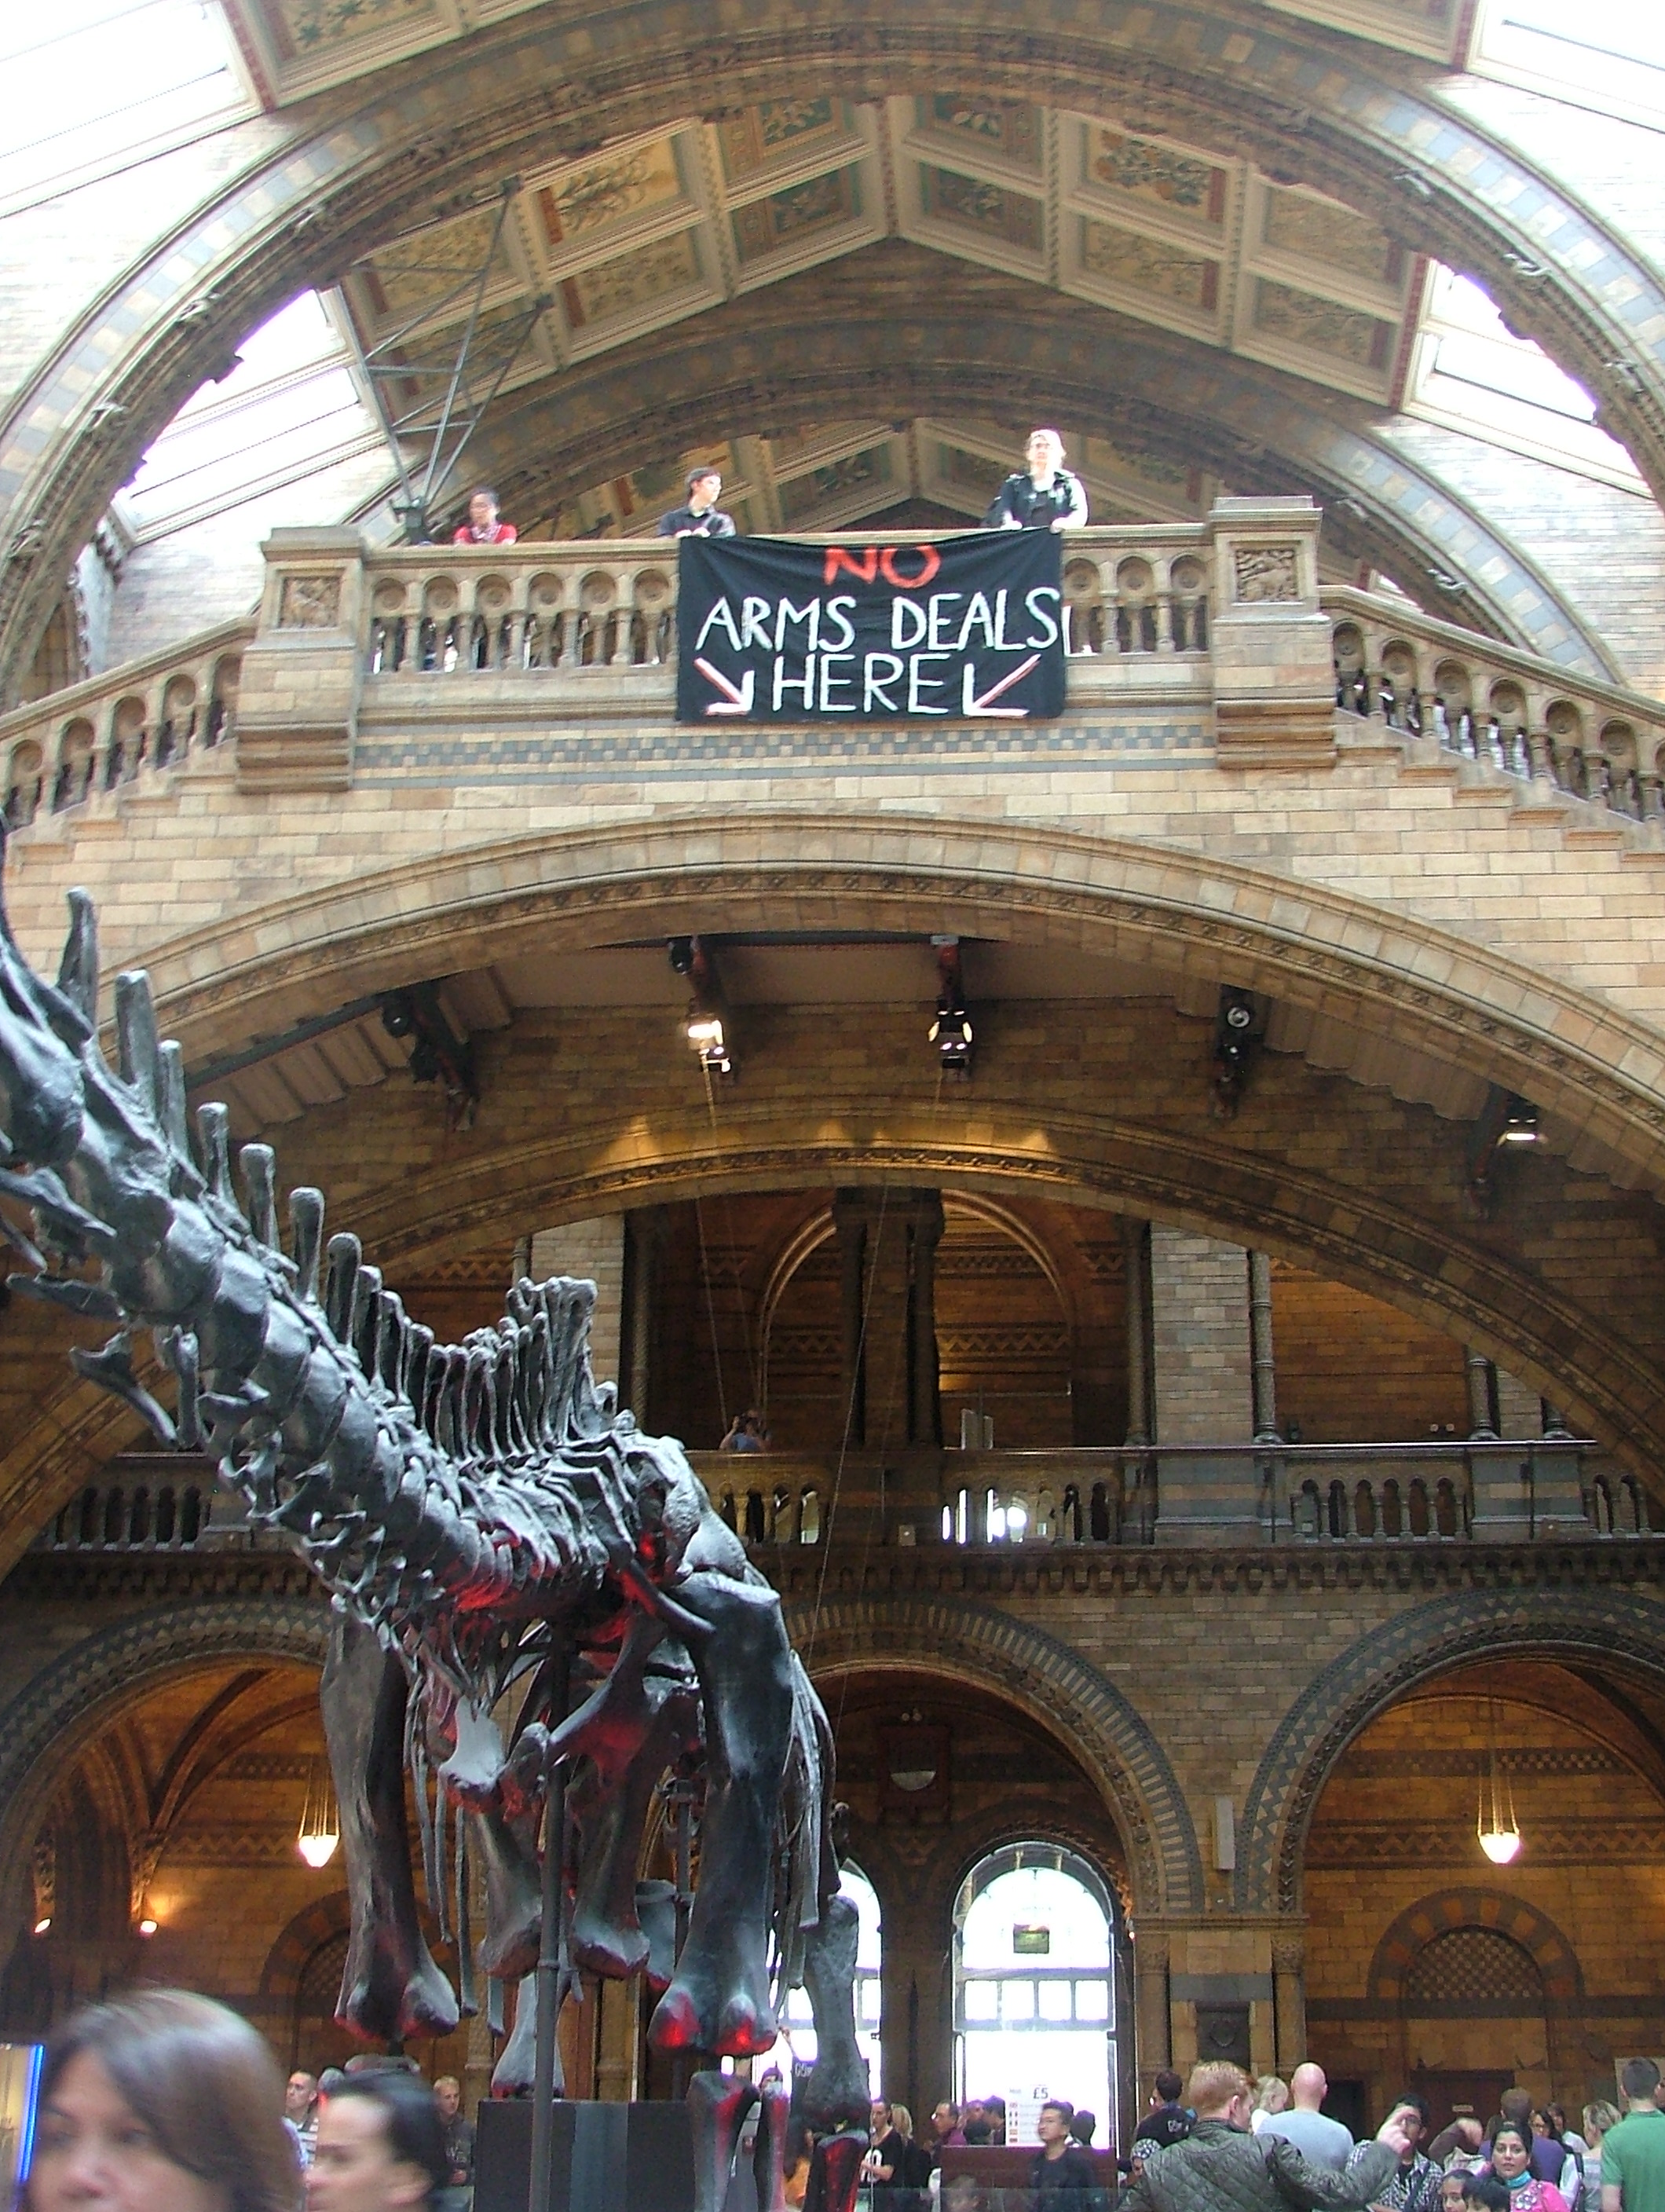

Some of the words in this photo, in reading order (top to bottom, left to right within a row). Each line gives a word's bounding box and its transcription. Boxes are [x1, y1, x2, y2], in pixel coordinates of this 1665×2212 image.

[825, 544, 941, 588] NO
[695, 595, 857, 651] ARMS
[891, 588, 1060, 650] DEALS
[773, 654, 950, 713] HERE
[1034, 2087, 1048, 2099] £5
